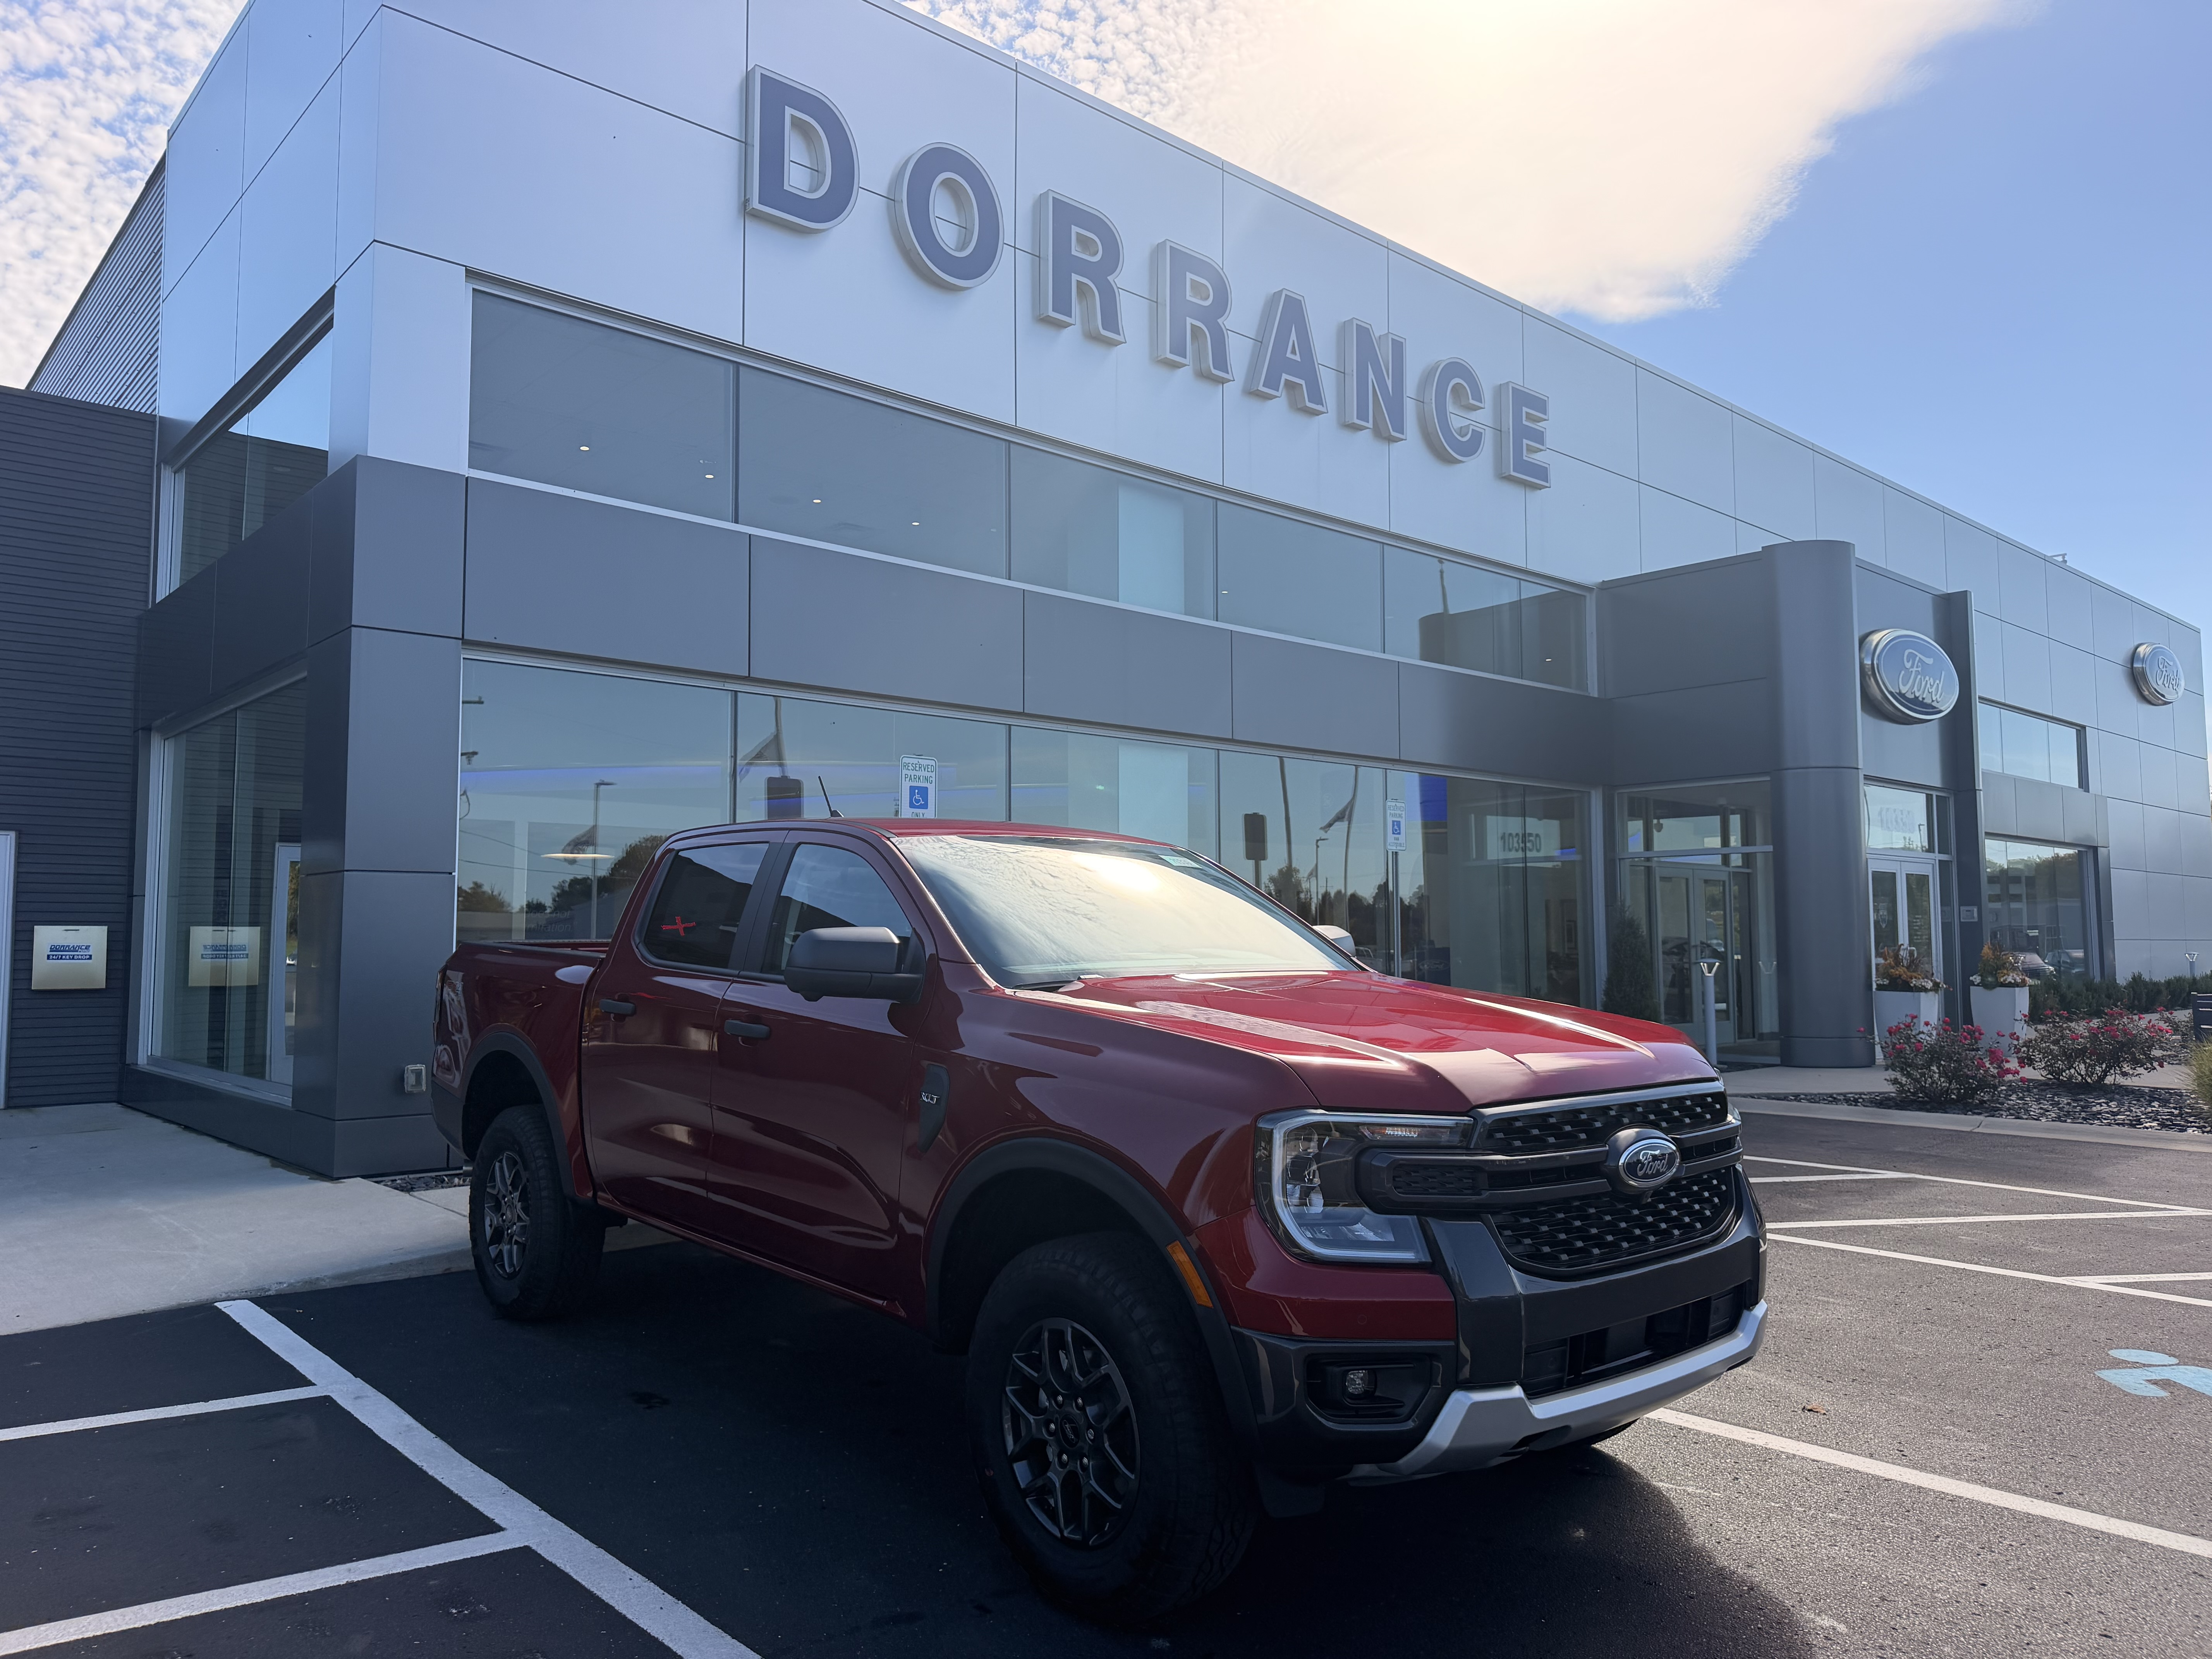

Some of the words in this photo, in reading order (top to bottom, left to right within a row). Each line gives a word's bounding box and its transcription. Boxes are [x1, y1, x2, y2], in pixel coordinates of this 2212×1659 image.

[744, 64, 1551, 489] DORRANCE
[1899, 649, 1945, 702] Ford
[2155, 656, 2180, 692] Ford
[903, 762, 934, 773] RESERVED
[904, 773, 933, 784] PARKING
[920, 1091, 940, 1104] XLT
[1637, 1149, 1669, 1176] Ford
